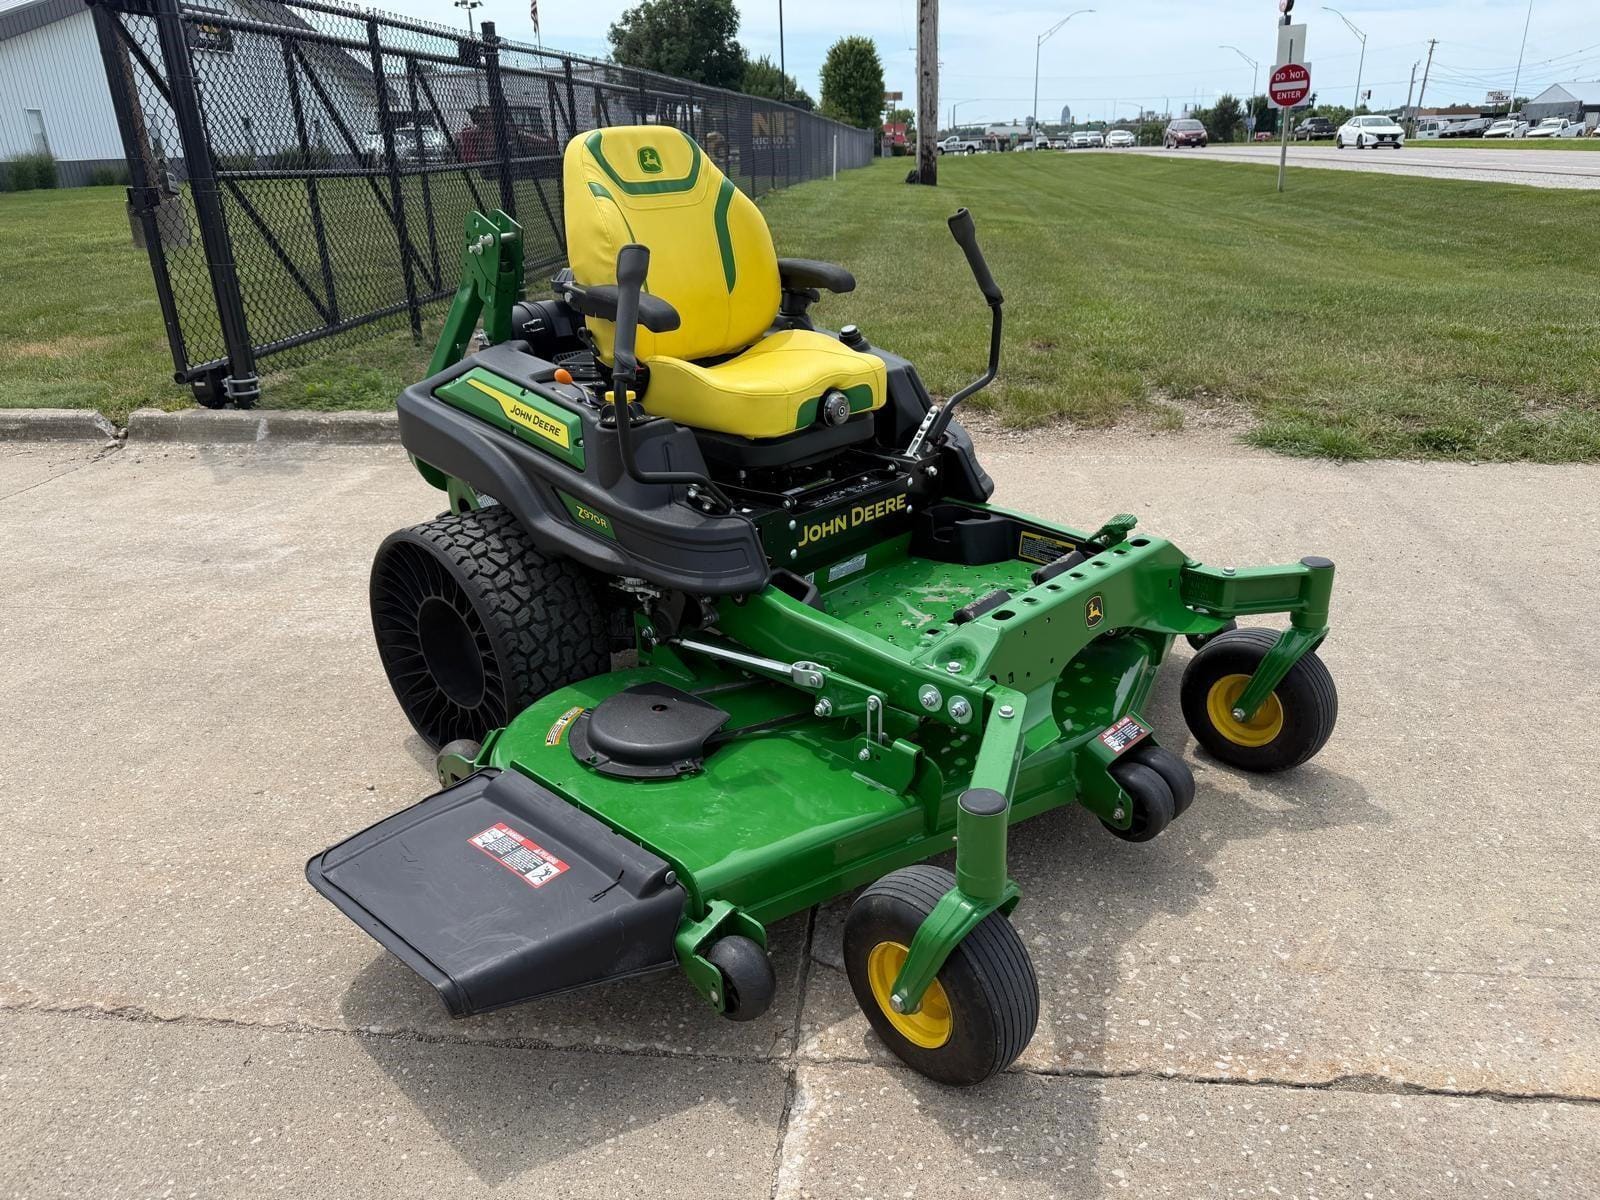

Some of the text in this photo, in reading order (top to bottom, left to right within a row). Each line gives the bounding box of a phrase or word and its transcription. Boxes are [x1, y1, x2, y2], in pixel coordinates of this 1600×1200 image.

[1275, 70, 1305, 81] DO NOT
[1276, 91, 1301, 100] ENTER
[510, 404, 561, 437] JOHN DEERE
[576, 505, 608, 529] Z970R
[798, 514, 847, 547] JOHN
[851, 493, 907, 527] DEERE
